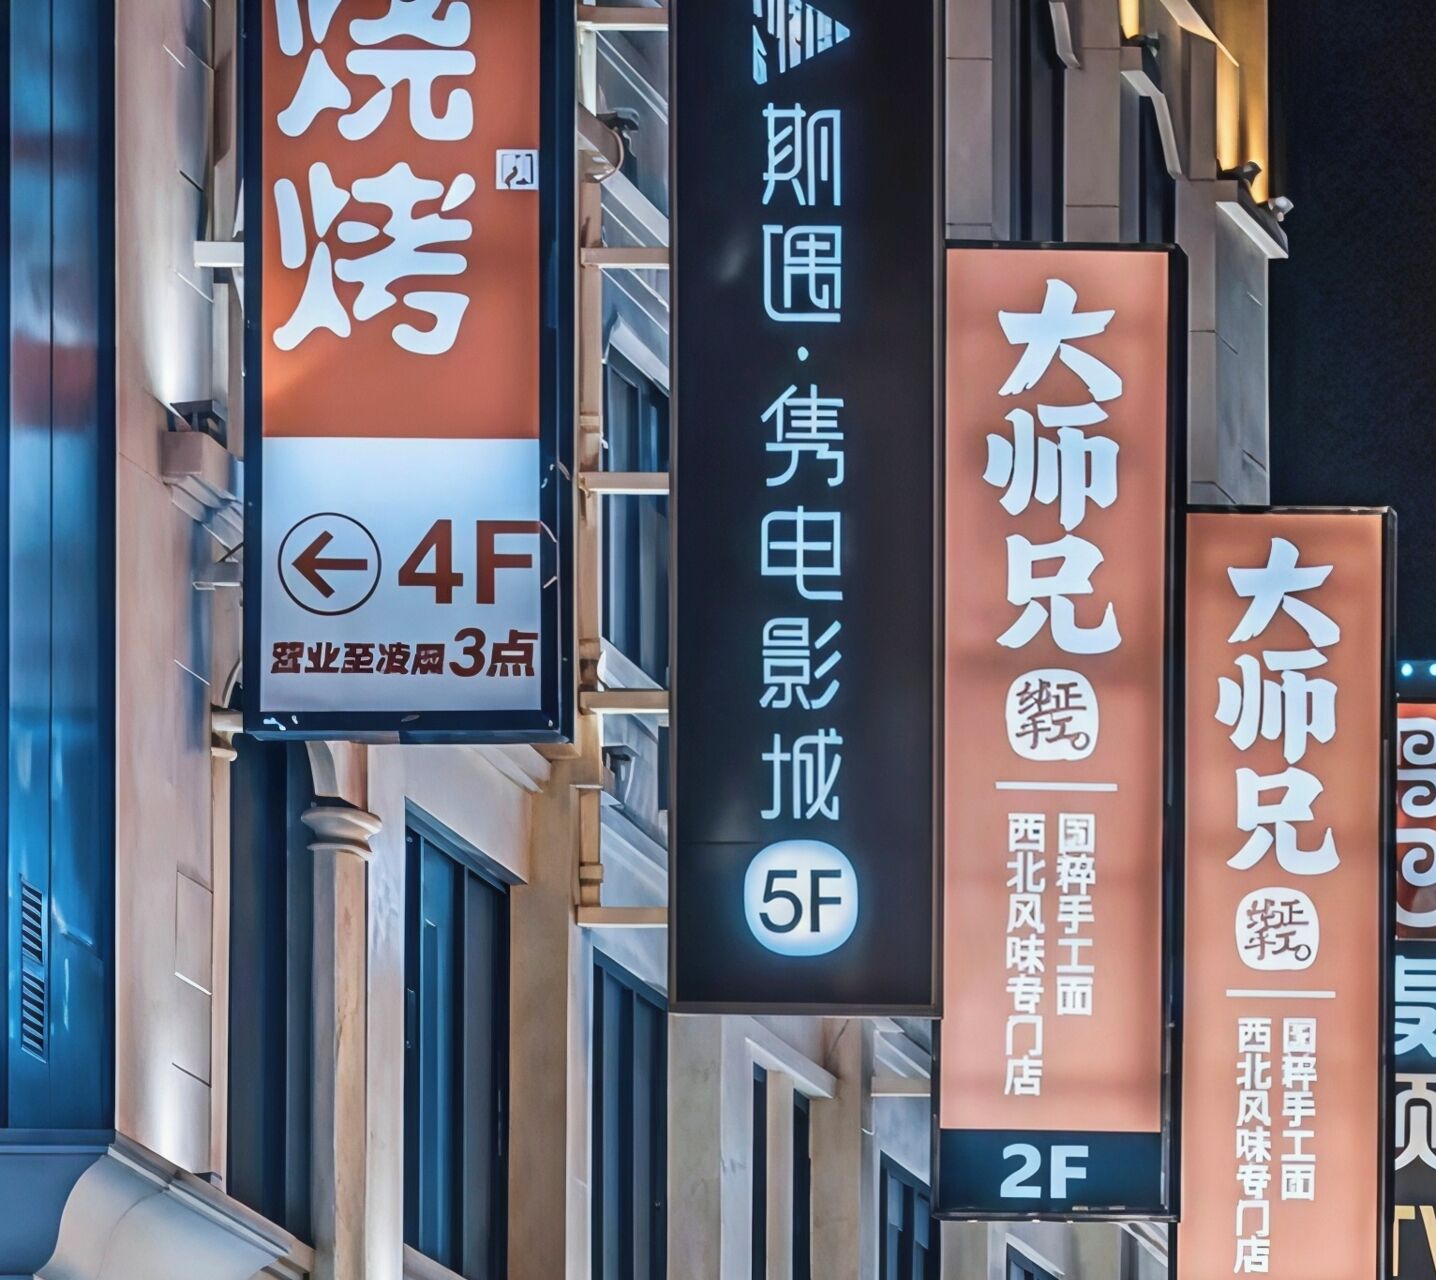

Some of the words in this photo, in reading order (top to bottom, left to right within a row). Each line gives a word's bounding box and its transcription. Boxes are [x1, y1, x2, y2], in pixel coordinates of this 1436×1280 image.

[273, 0, 476, 355] 烧烤
[397, 519, 540, 605] 4F
[983, 278, 1122, 655] 大师兄
[1215, 537, 1341, 875] 大师兄
[758, 869, 842, 934] 5F
[1004, 812, 1046, 1096] 西北风味专门店
[1000, 1143, 1089, 1200] 2F
[1233, 1017, 1272, 1273] 西北风味专门店
